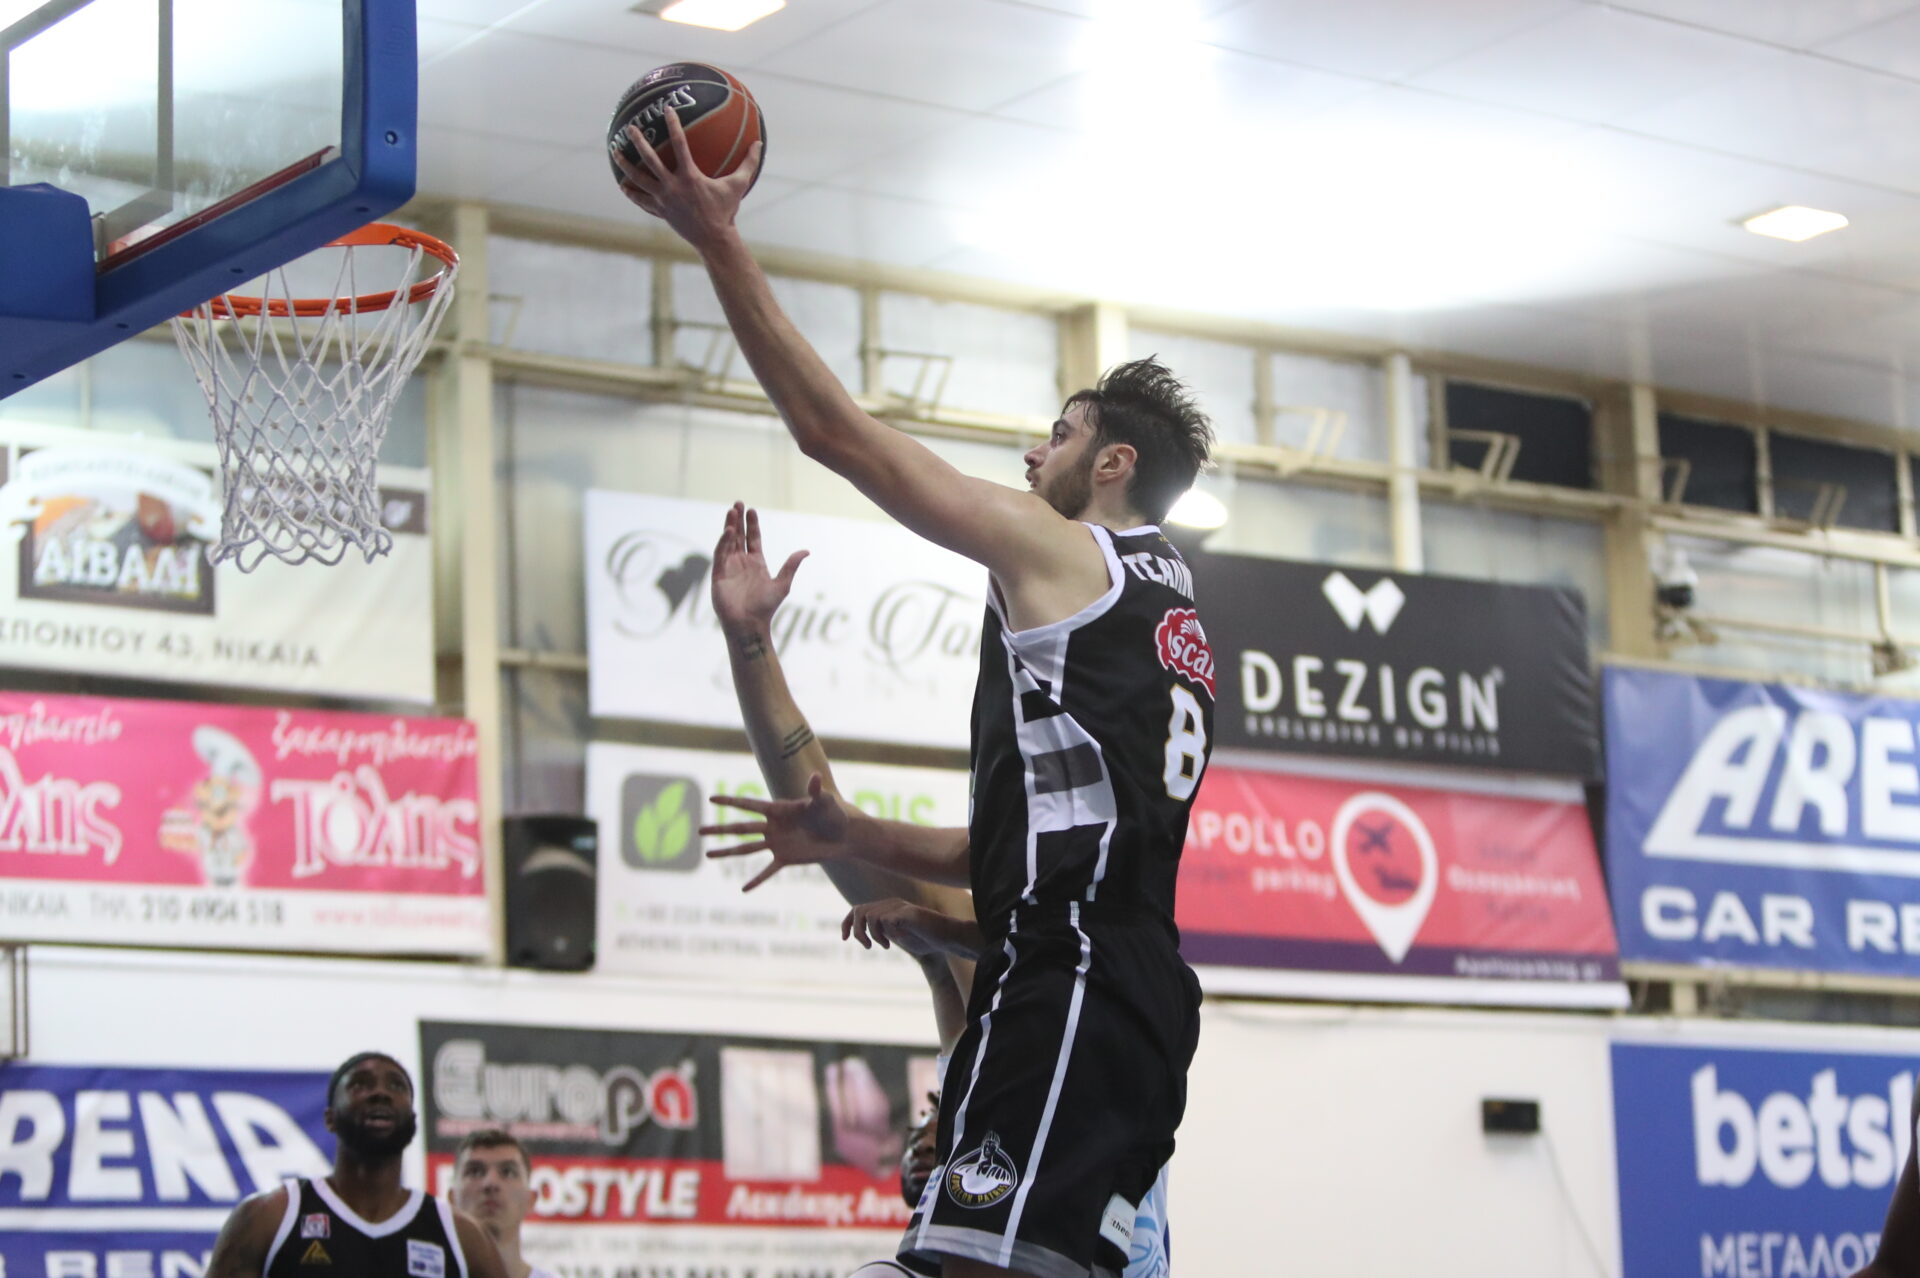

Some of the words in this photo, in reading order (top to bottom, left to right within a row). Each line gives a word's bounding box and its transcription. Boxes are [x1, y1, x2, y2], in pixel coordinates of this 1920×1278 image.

[606, 530, 850, 657] Mgic
[863, 580, 982, 682] Ta
[1163, 683, 1206, 801] 8
[1643, 704, 1920, 858] ARE
[1641, 886, 1816, 950] CAR
